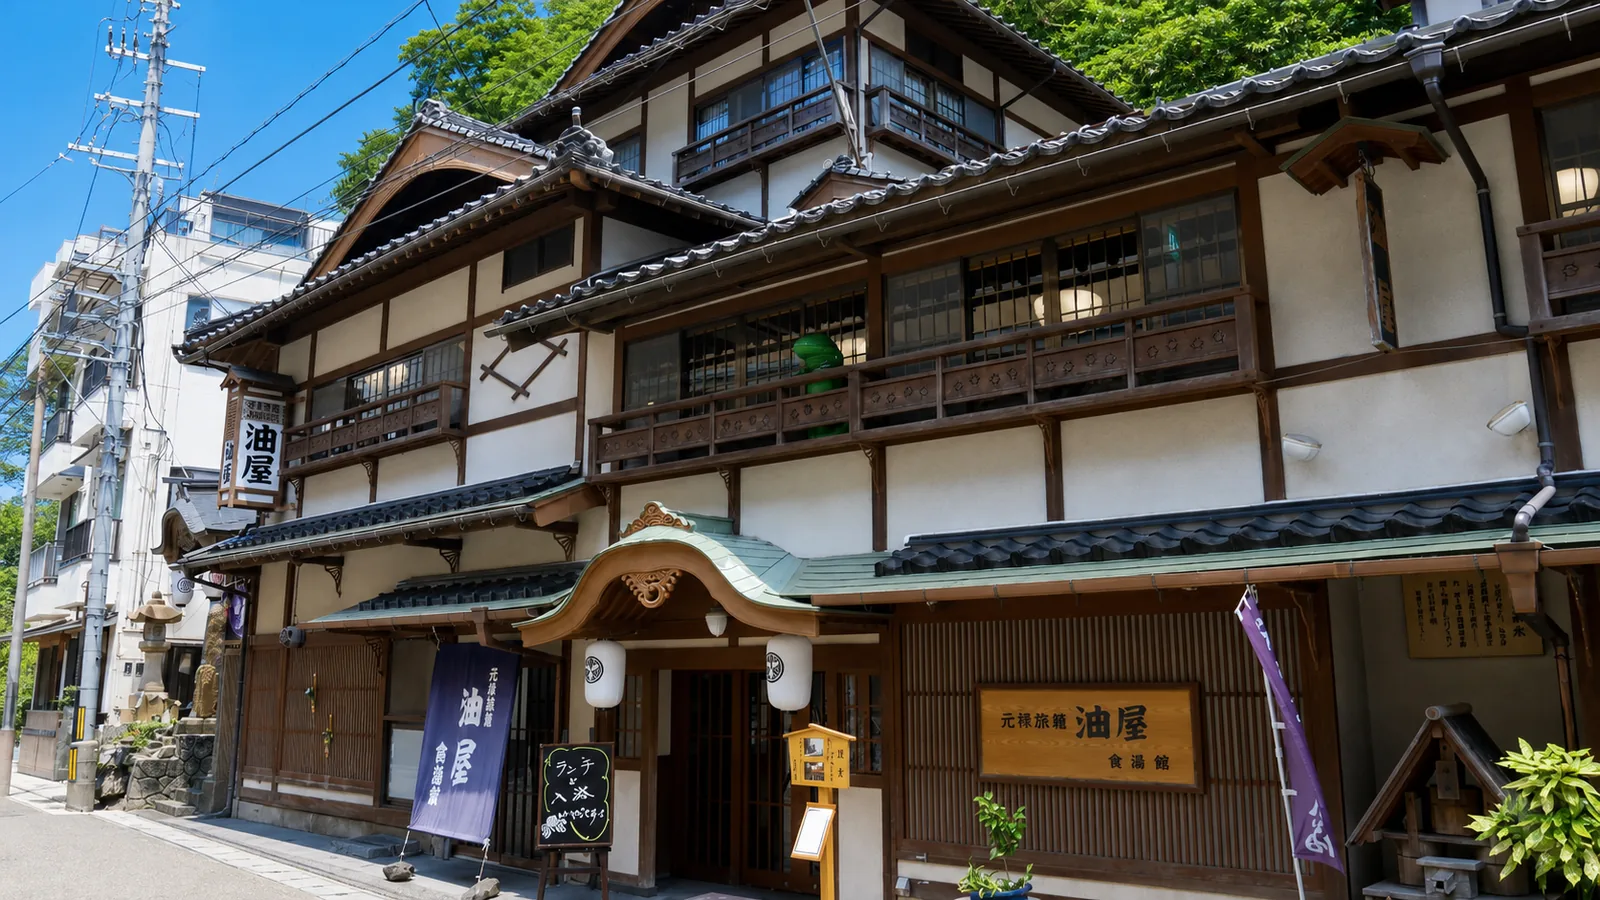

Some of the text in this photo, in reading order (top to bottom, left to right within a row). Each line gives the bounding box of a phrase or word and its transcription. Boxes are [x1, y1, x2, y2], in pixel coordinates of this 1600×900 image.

[242, 422, 277, 485] 油屋
[450, 686, 483, 787] 油屋
[1000, 704, 1148, 742] 元禄旅籠 油屋
[556, 756, 595, 777] ランチ
[1108, 753, 1170, 771] 食湯館
[551, 785, 595, 805] 入浴
